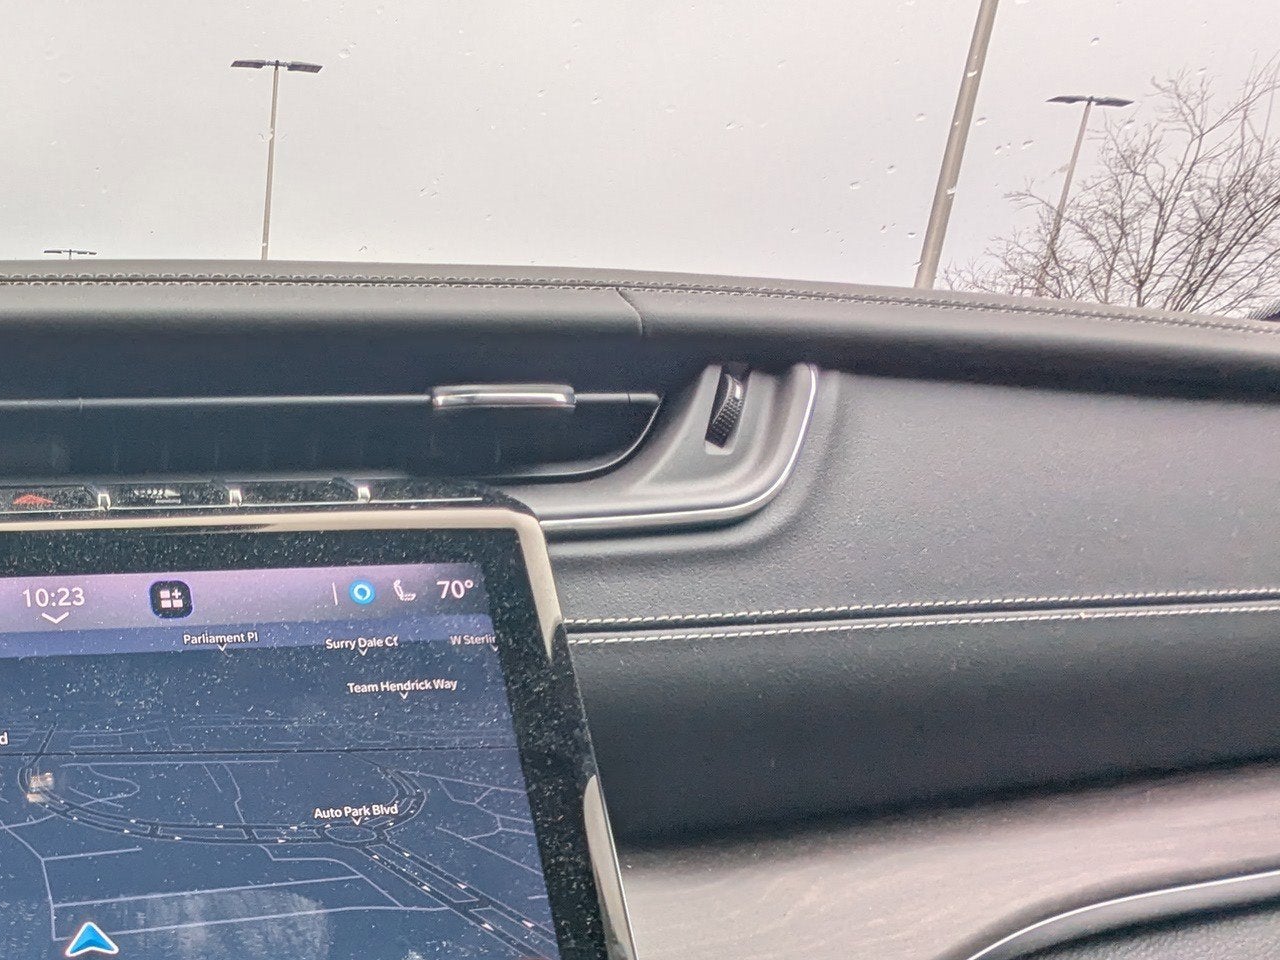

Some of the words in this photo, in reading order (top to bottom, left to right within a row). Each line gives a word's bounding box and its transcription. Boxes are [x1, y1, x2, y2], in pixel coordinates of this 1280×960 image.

[437, 578, 474, 600] 70°
[22, 586, 86, 609] 10:23
[183, 632, 246, 646] Parliament
[325, 638, 356, 651] Surry
[358, 637, 384, 648] Dale
[449, 635, 462, 646] W
[347, 682, 379, 694] Team
[380, 679, 432, 692] Hendrick
[433, 678, 458, 692] Way
[313, 806, 341, 819] Auto
[342, 804, 369, 818] Park
[371, 802, 399, 817] Blvd
